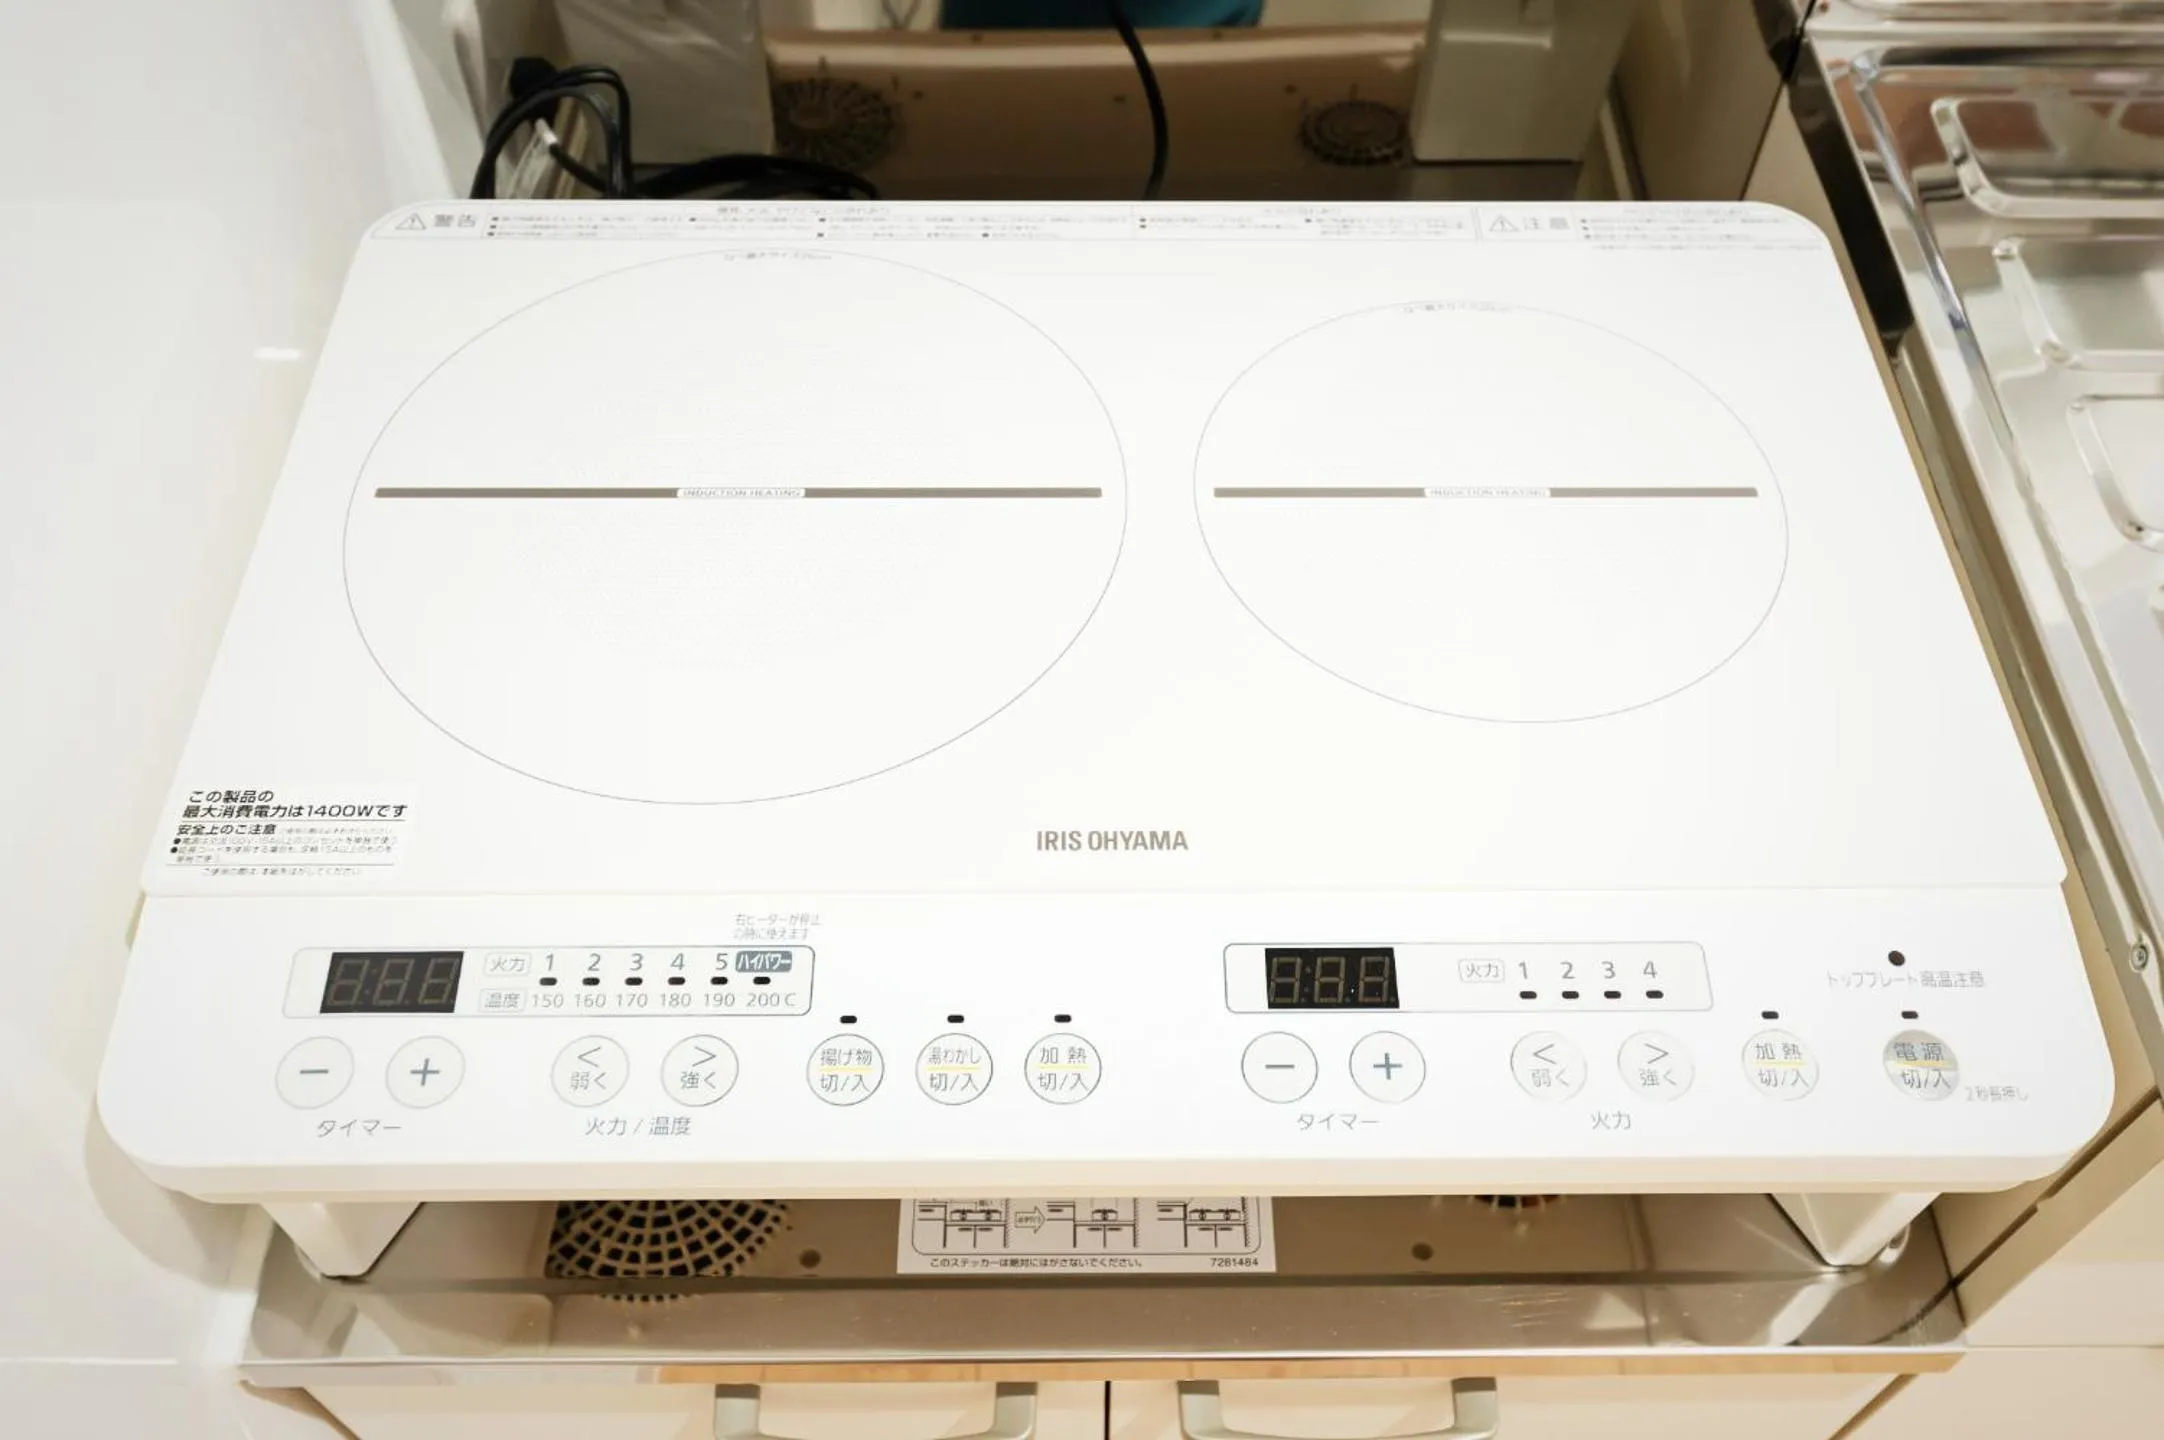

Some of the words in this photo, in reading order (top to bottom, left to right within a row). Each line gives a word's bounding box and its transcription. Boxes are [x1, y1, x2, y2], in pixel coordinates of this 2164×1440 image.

[189, 790, 274, 803] この製品の
[182, 804, 408, 819] 最大消費電力は1400Wです
[1037, 830, 1082, 851] IRIS
[1088, 830, 1189, 851] OHYAMA
[490, 956, 525, 972] 火力
[545, 953, 554, 972] 1
[588, 953, 601, 972] 2
[630, 953, 643, 972] 3
[670, 953, 685, 971] 4
[715, 952, 728, 971] 5
[737, 952, 791, 971] ハイパワー
[1466, 962, 1499, 978] 火力
[1518, 961, 1528, 979] 1
[1561, 961, 1575, 979] 2
[1601, 961, 1615, 979] 3
[1643, 961, 1658, 979] 4
[532, 993, 564, 1008] 150
[574, 993, 606, 1008] 160
[616, 993, 648, 1008] 170
[660, 992, 692, 1008] 180
[703, 992, 735, 1008] 190
[820, 1048, 872, 1066] 揚げ物
[1894, 1043, 1944, 1061] 電源
[570, 1071, 607, 1090] 弱く
[680, 1071, 716, 1090] 強く
[820, 1074, 870, 1093] 切/入
[929, 1073, 979, 1092] 切/入
[1038, 1073, 1088, 1092] 切/入
[1531, 1070, 1570, 1088] 弱く
[1640, 1070, 1677, 1087] 強く
[1758, 1069, 1808, 1087] 切/入
[1901, 1069, 1951, 1089] 切/入
[317, 1119, 402, 1137] タイマー
[1298, 1114, 1379, 1131] タイマー
[1591, 1111, 1631, 1130] 火力
